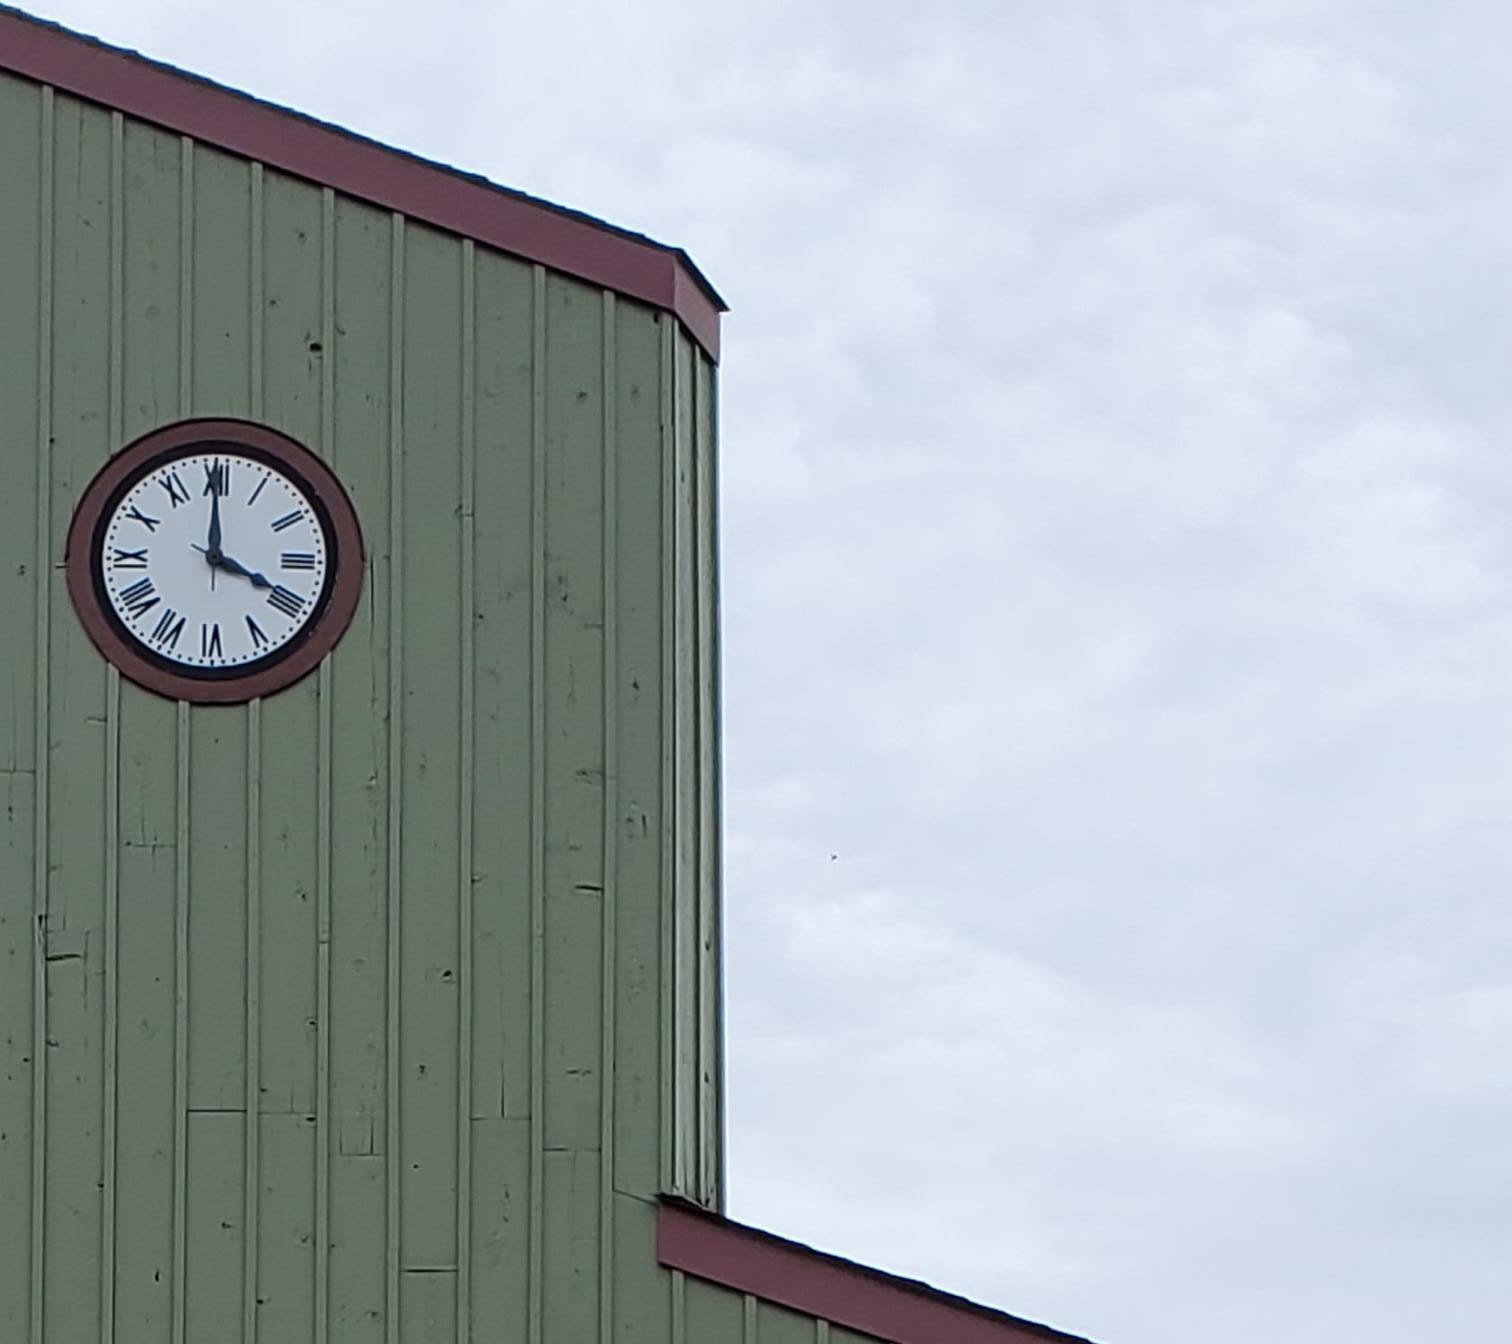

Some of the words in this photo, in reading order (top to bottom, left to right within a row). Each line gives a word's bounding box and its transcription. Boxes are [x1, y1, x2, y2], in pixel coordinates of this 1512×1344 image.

[158, 472, 191, 508] XI
[125, 505, 161, 532] X
[271, 509, 305, 532] II
[113, 549, 148, 569] IX
[281, 553, 315, 570] III
[119, 577, 161, 620] VIII
[151, 608, 186, 650] VII
[202, 623, 222, 658] VI
[245, 615, 269, 648] V
